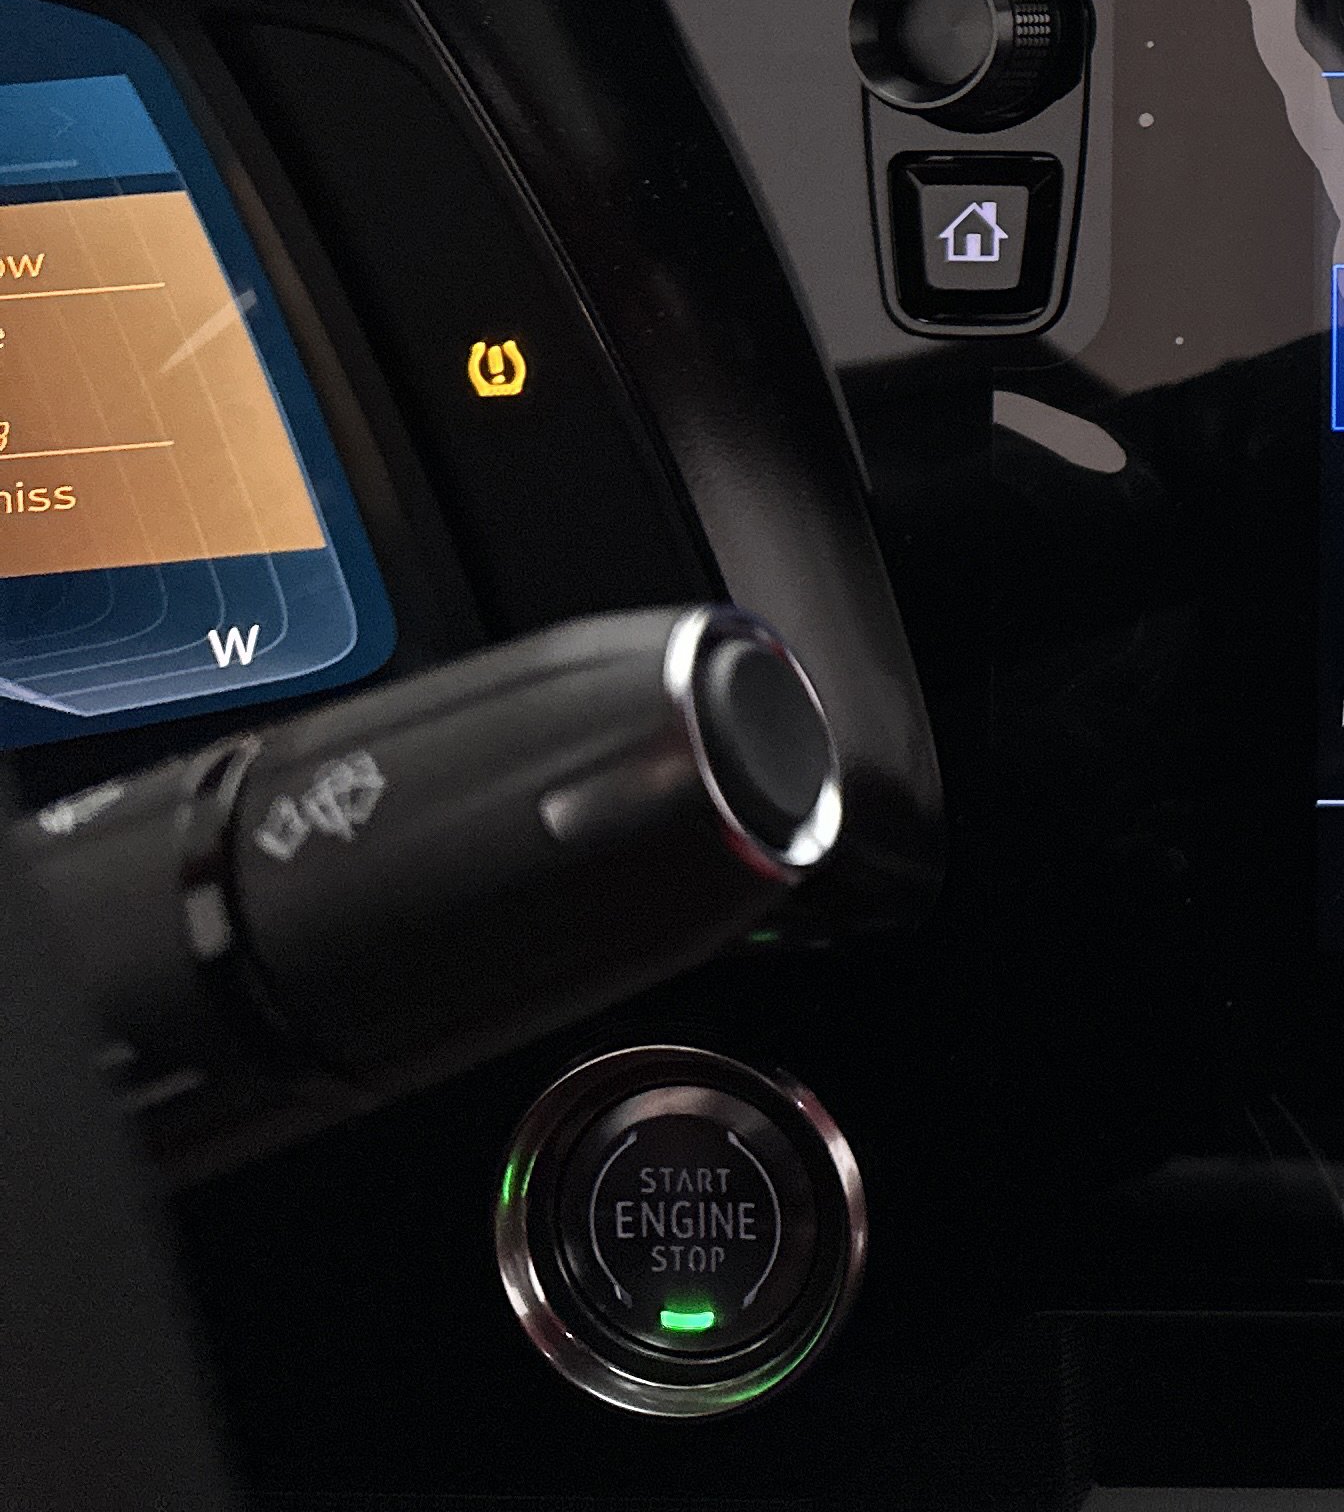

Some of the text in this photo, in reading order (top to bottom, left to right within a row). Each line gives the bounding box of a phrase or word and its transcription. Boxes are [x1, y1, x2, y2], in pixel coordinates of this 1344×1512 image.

[208, 624, 260, 669] W
[639, 1167, 731, 1193] START
[616, 1200, 756, 1239] ENGINE
[651, 1245, 725, 1273] STOP
